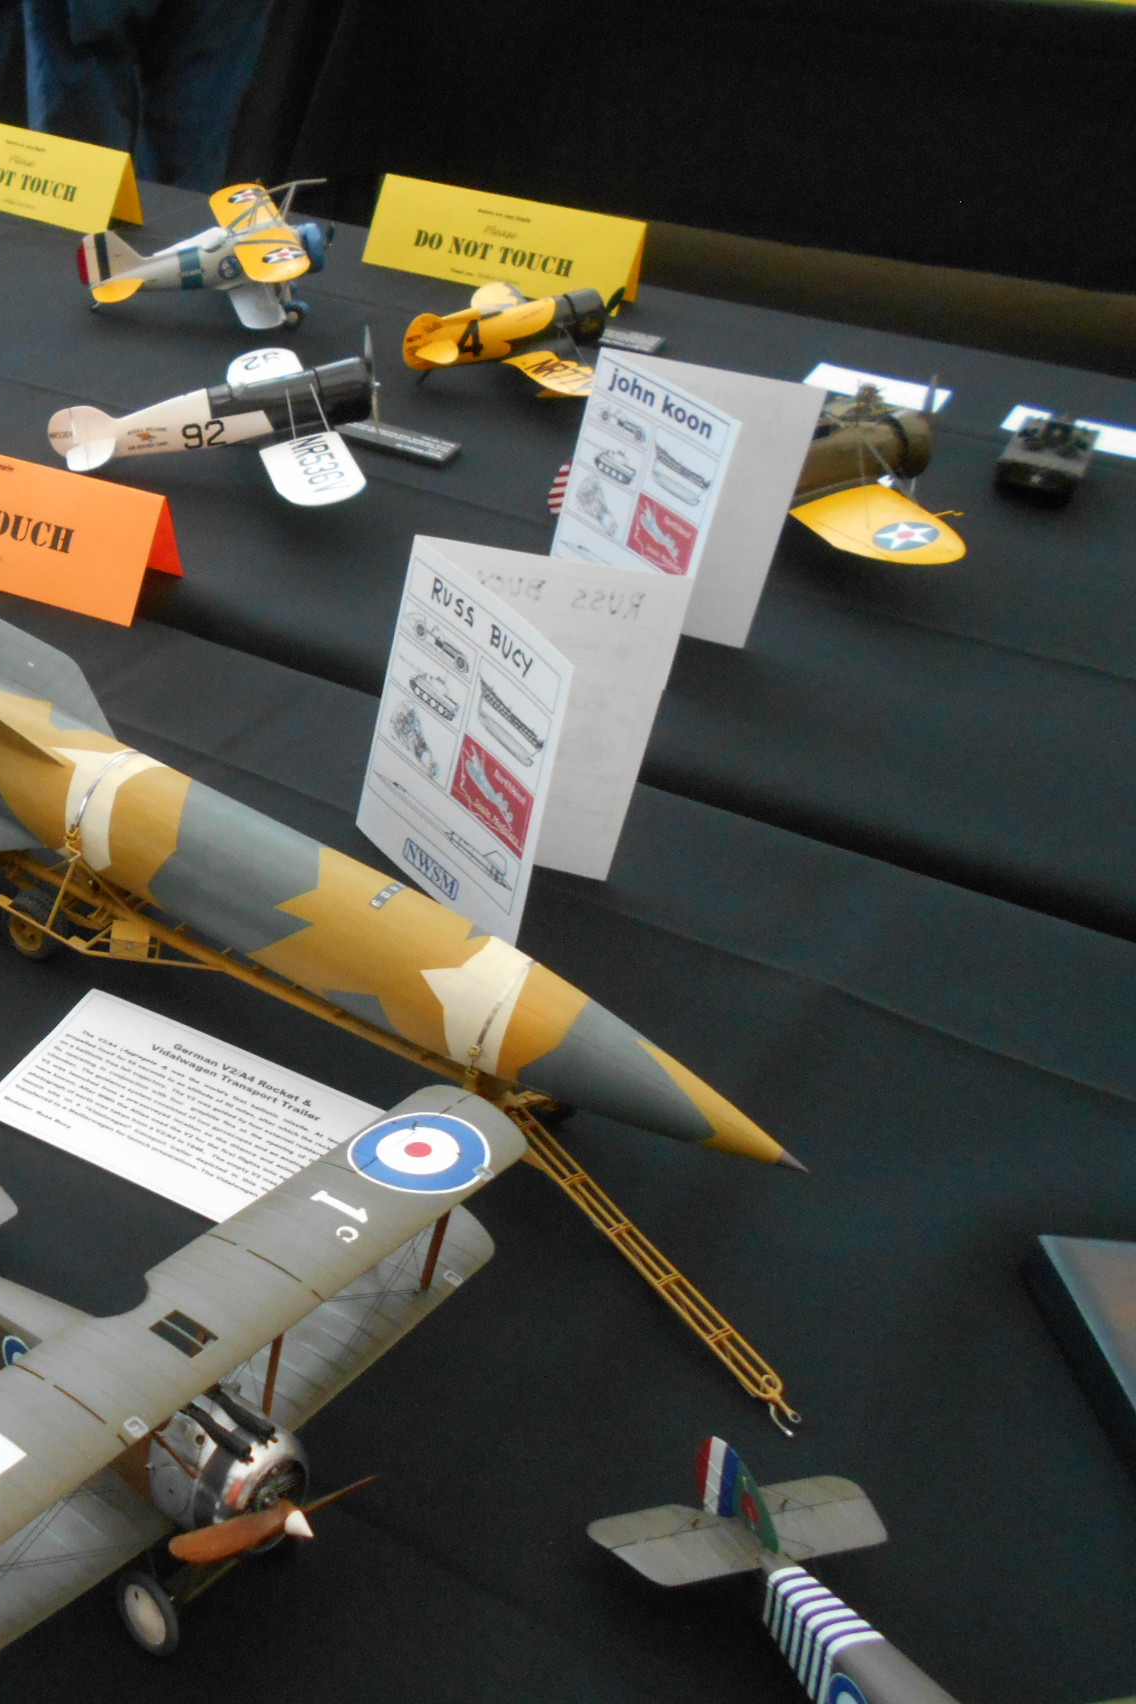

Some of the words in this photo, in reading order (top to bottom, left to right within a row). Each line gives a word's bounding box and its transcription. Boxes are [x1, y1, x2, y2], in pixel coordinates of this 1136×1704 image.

[20, 173, 77, 202] TOUCH
[413, 228, 444, 250] DO
[447, 235, 493, 260] NOT
[499, 246, 573, 277] TOUCH
[457, 319, 484, 358] 4
[607, 367, 656, 408] john
[662, 394, 713, 439] koon
[181, 419, 227, 450] 92
[431, 577, 474, 628] RUSS
[490, 624, 533, 678] BUCY
[407, 841, 457, 899] NWSM
[151, 1043, 217, 1077] Vidalwagen
[220, 1073, 278, 1104] Transport
[281, 1099, 321, 1121] Trailer
[172, 1042, 218, 1067] German
[256, 1078, 300, 1102] Rocket
[301, 1098, 312, 1107] &
